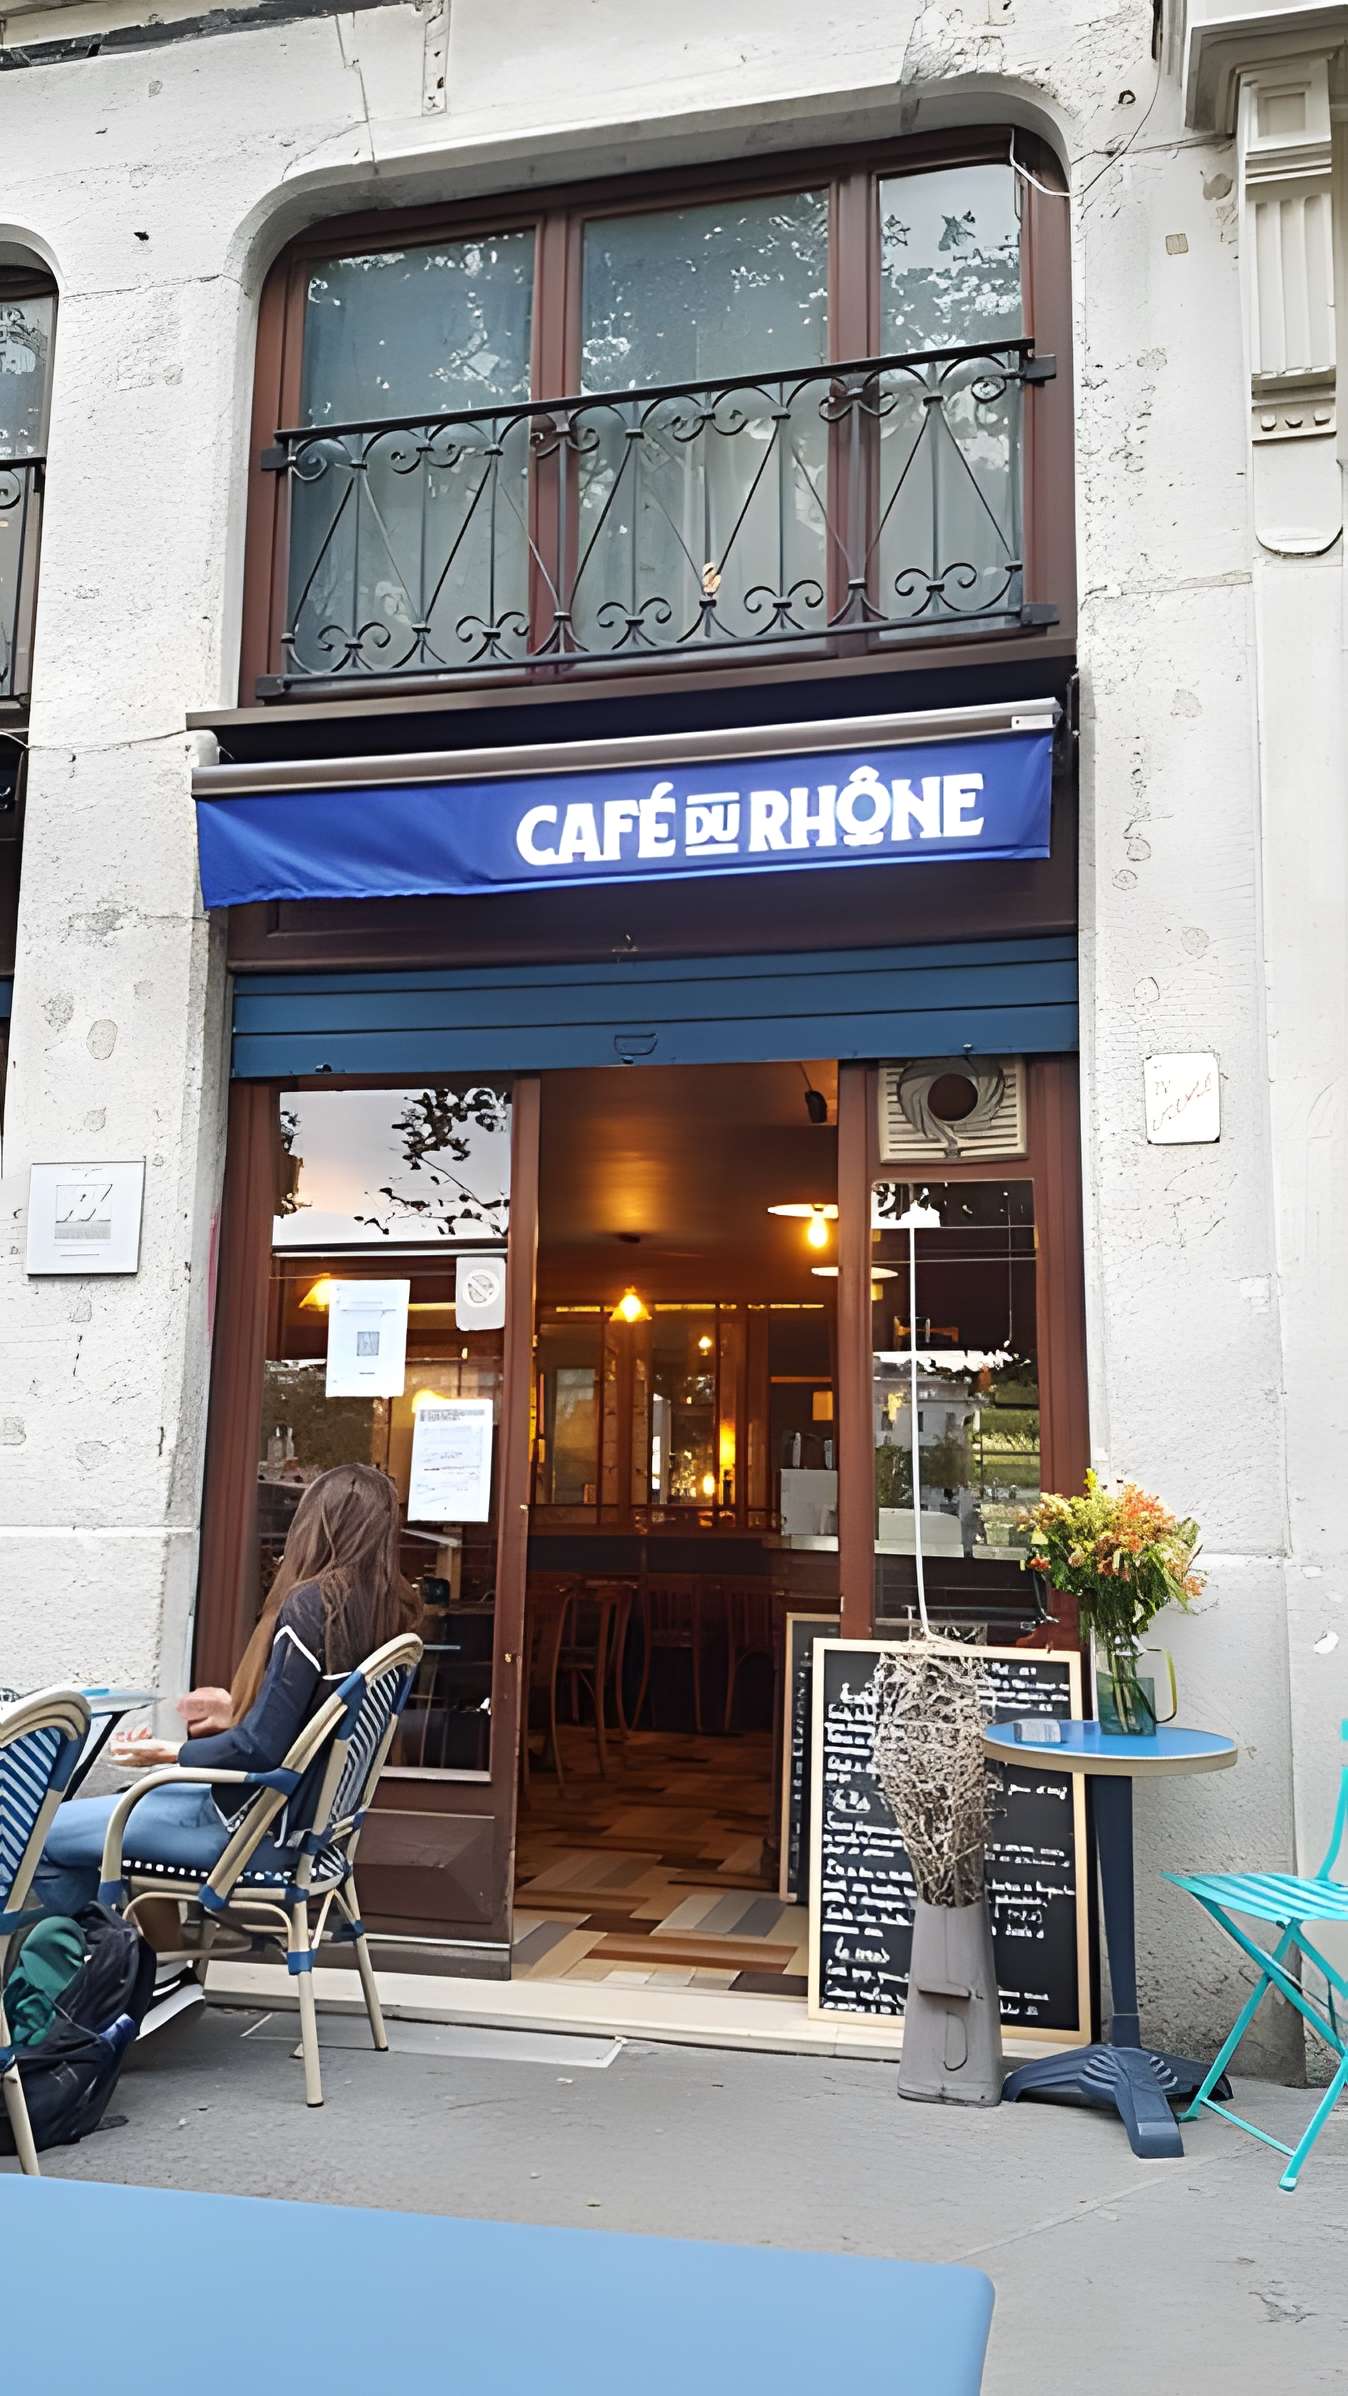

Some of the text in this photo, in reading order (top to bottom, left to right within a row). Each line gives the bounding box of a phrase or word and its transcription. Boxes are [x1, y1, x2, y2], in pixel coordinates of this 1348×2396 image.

[516, 766, 985, 866] CAFÉ DU RHÔNE
